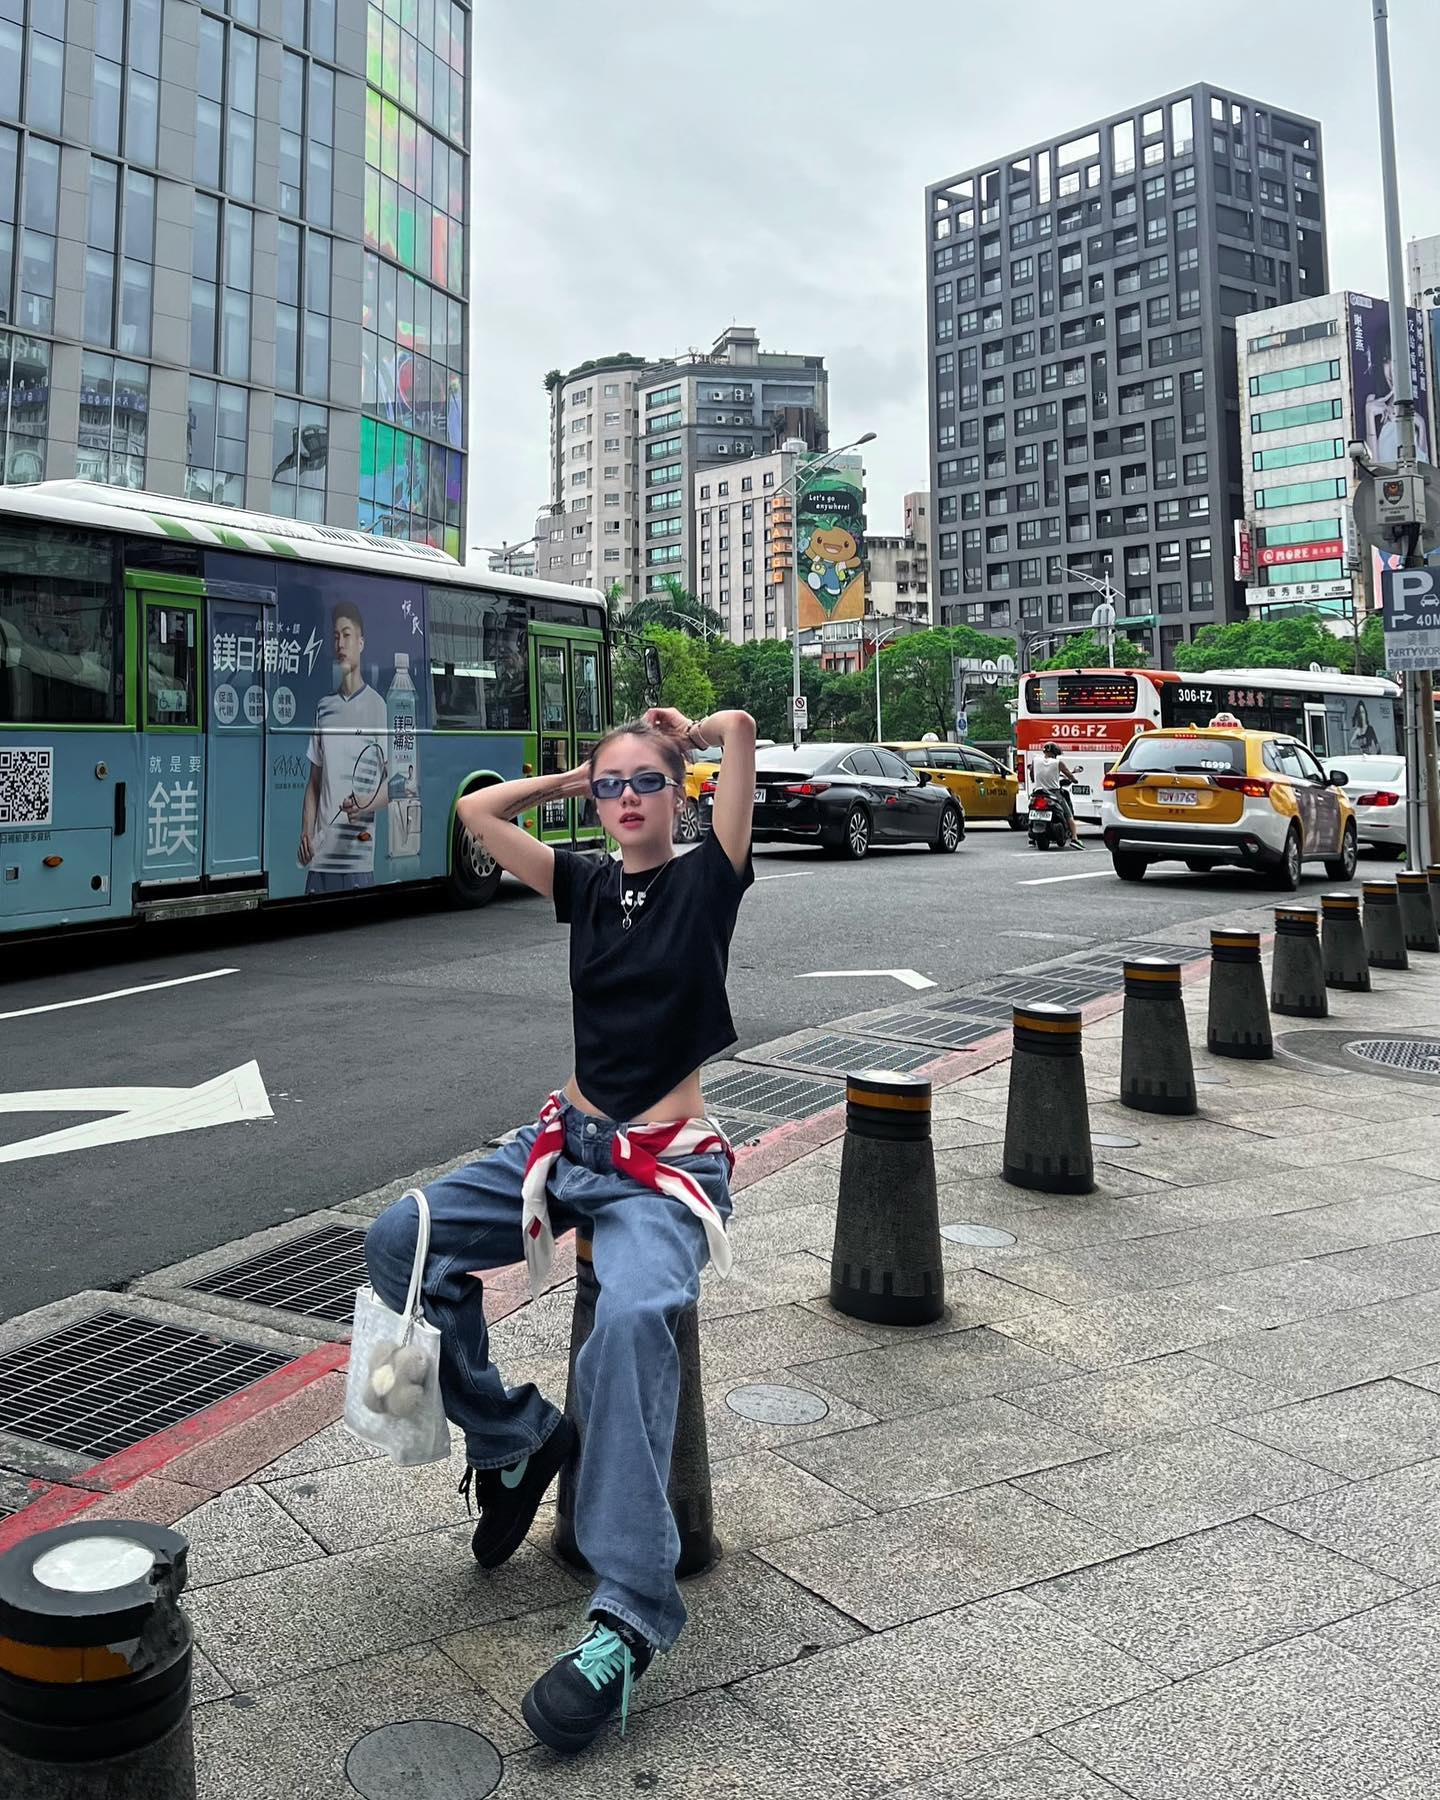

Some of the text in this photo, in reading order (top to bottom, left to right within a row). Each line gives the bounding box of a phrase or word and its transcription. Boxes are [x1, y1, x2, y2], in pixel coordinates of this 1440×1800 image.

[1392, 571, 1434, 611] P
[213, 633, 301, 674] 鎂日補給
[1051, 724, 1107, 737] 306-FZ
[149, 755, 201, 773] 就是要
[146, 780, 199, 856] 鎂
